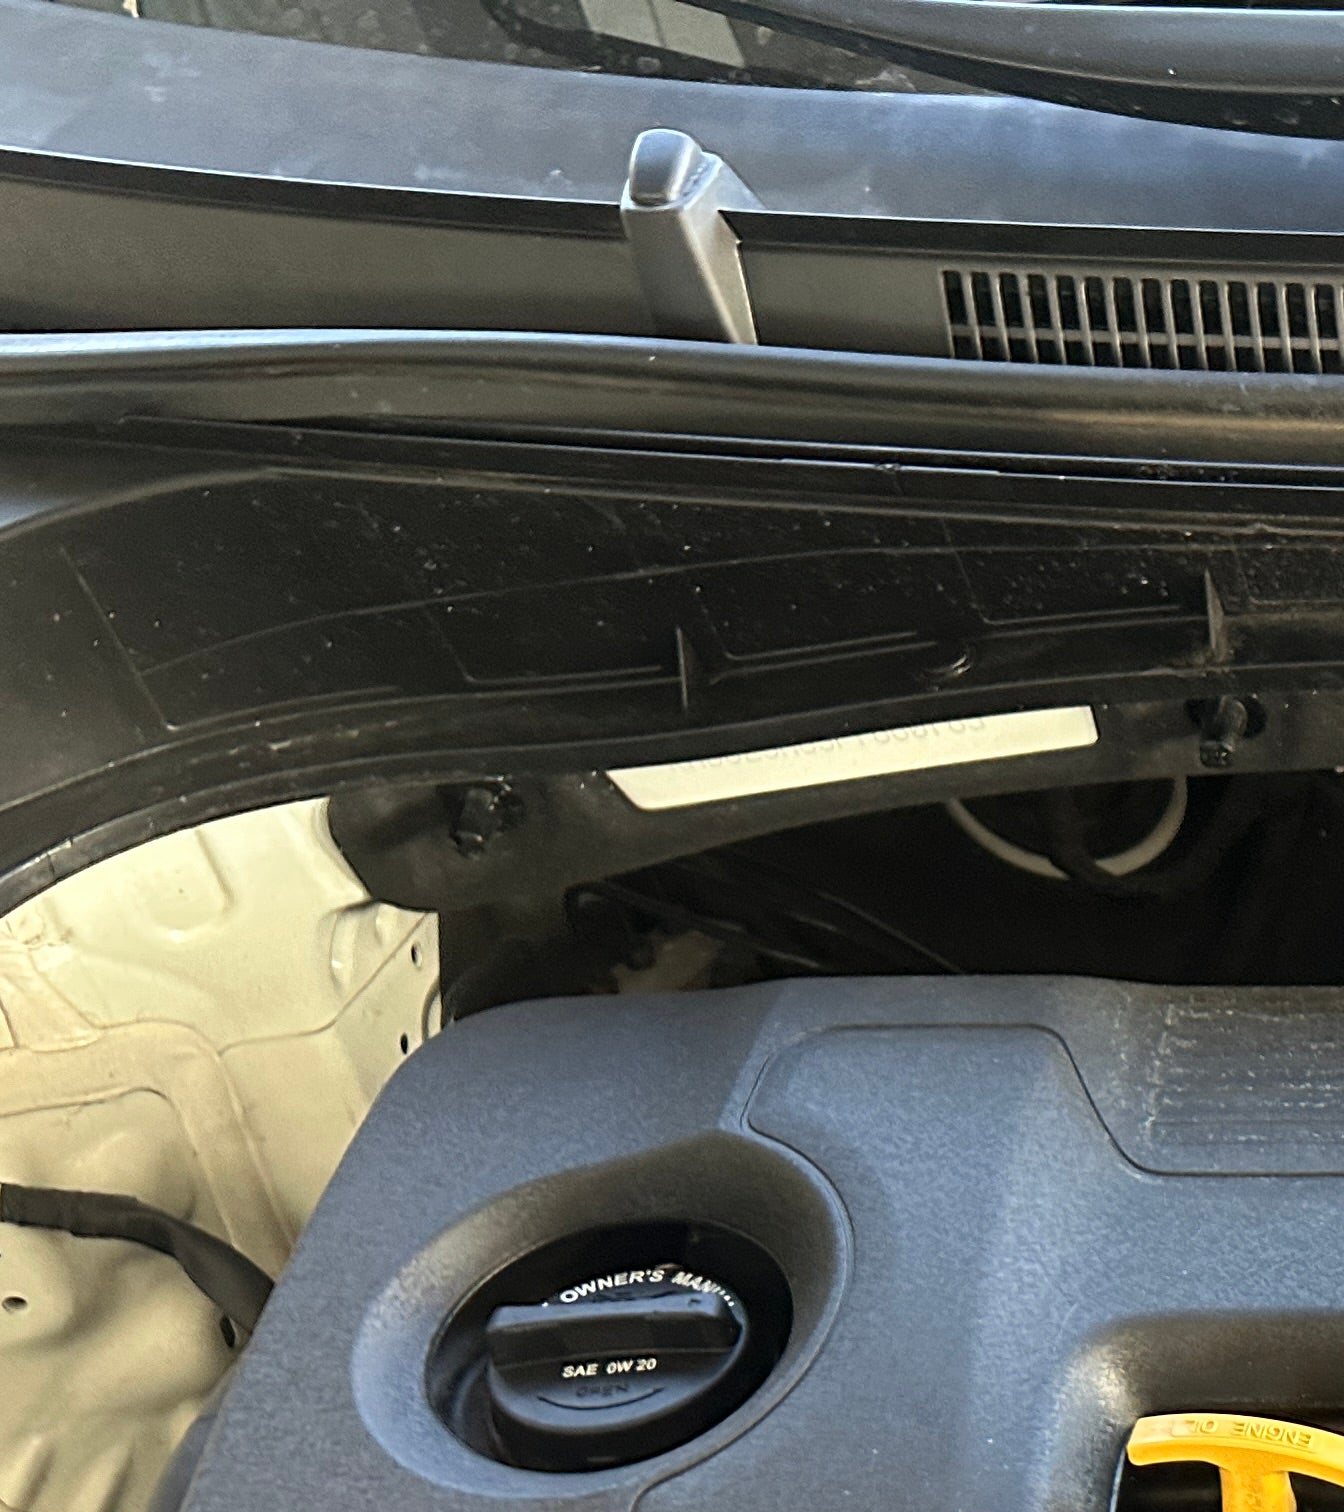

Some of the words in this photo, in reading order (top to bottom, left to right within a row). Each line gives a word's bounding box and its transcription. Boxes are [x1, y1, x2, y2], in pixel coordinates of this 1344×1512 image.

[560, 1269, 665, 1303] OWNER'S
[672, 1271, 735, 1306] MAN
[562, 1363, 600, 1379] SAE
[606, 1359, 633, 1376] 0W
[636, 1357, 658, 1372] 20
[1230, 1421, 1313, 1448] ENGINE
